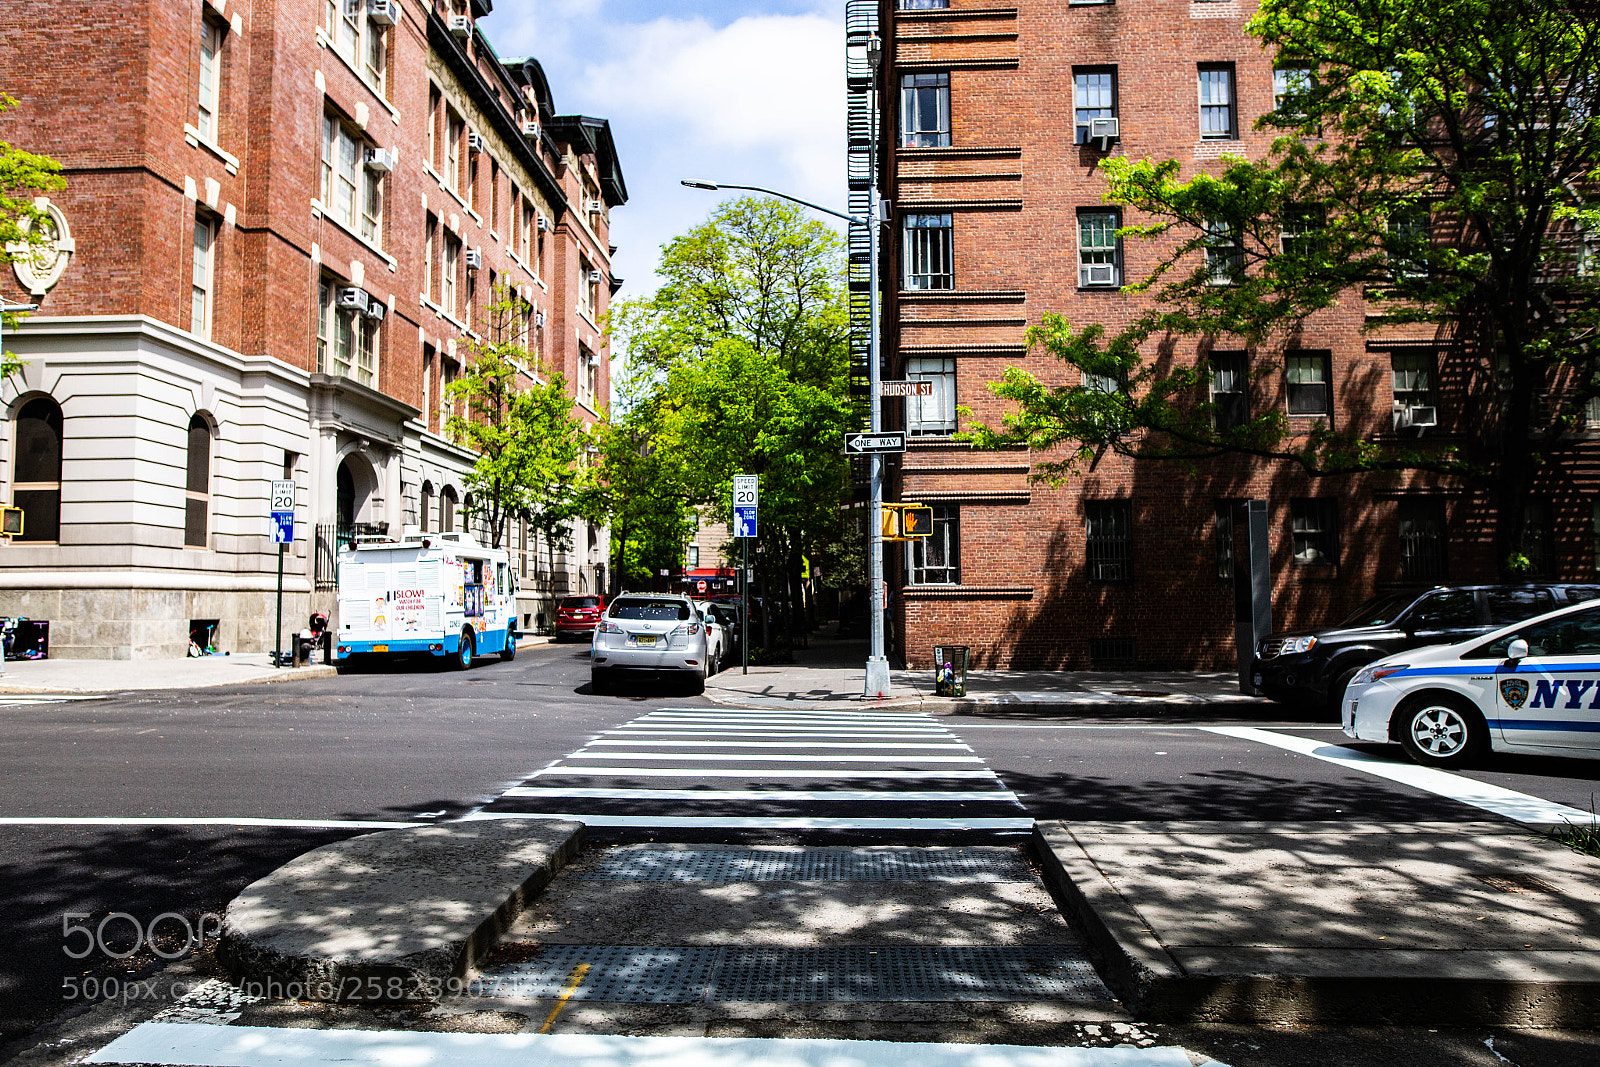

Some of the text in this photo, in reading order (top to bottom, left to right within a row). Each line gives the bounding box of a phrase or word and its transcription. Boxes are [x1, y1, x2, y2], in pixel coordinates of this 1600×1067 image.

[884, 384, 931, 396] HUDSON ST
[854, 438, 897, 447] ONE WAY
[274, 496, 292, 508] 20
[737, 491, 755, 503] 20
[396, 589, 425, 599] SLOW!
